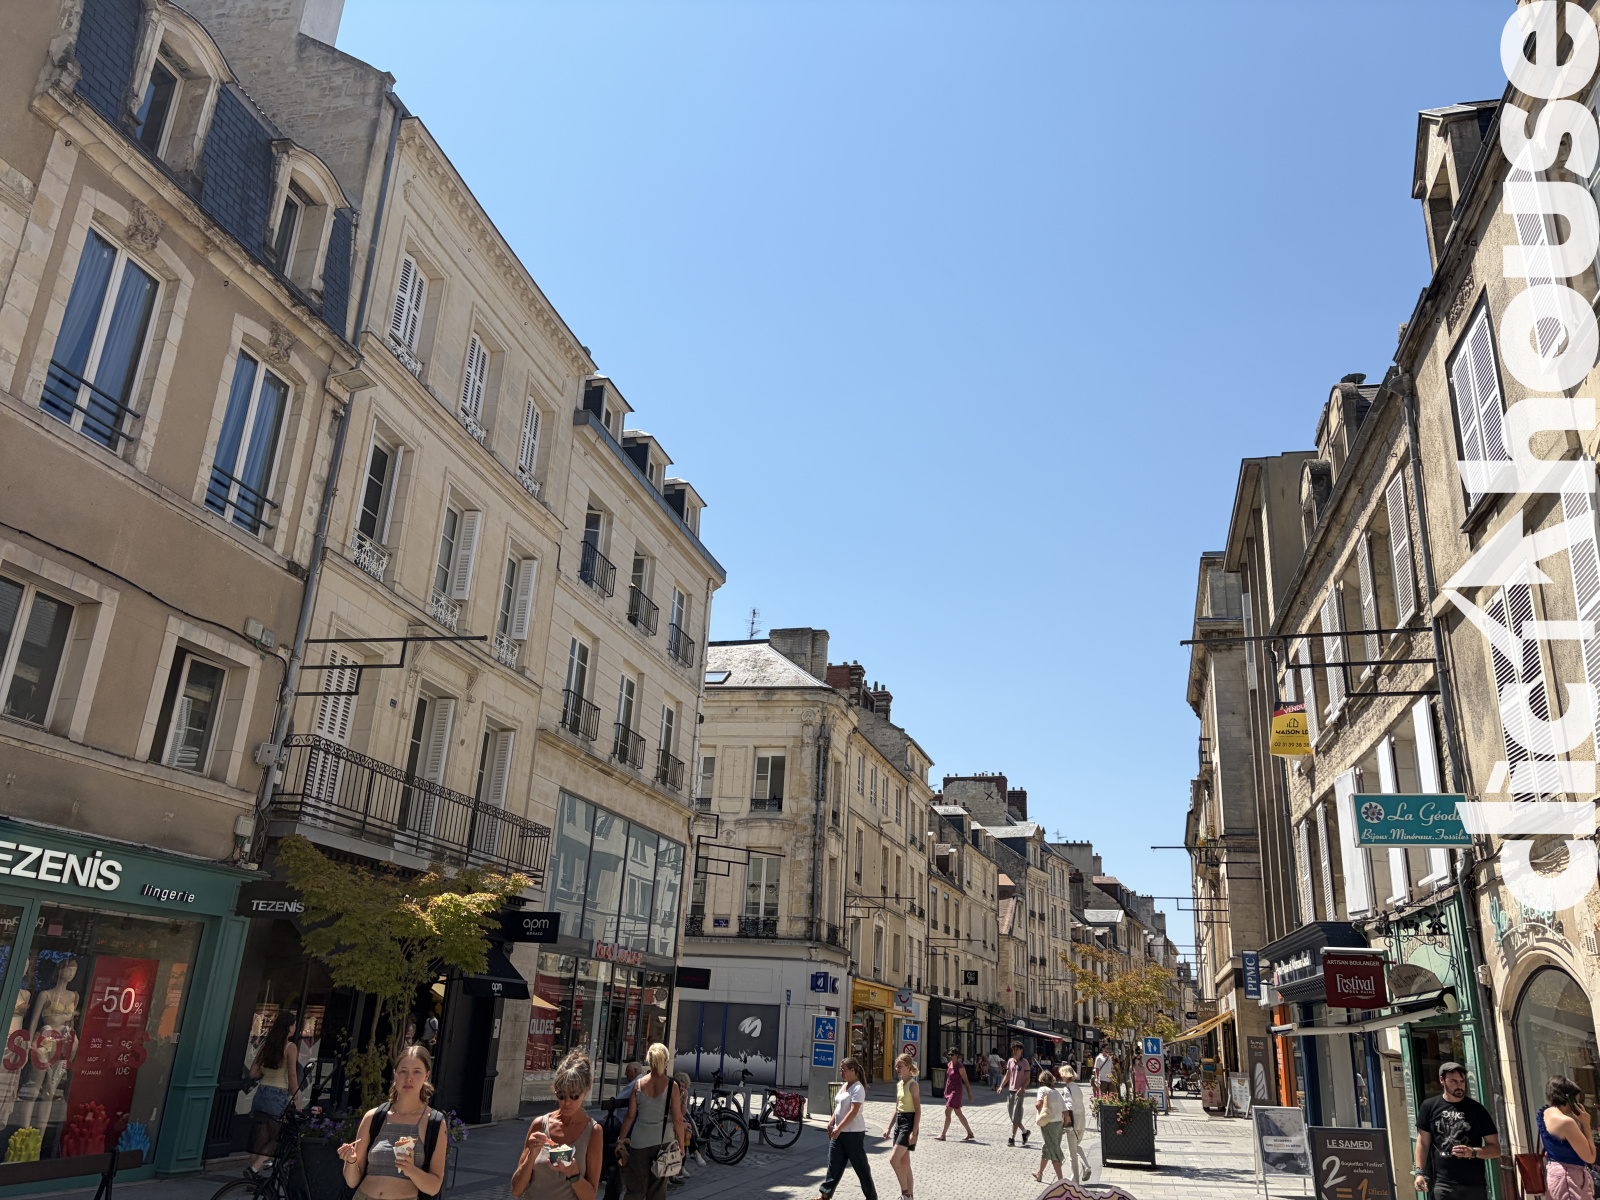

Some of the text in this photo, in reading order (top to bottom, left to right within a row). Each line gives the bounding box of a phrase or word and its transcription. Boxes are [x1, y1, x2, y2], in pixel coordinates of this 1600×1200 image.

[1284, 703, 1305, 713] VENDU
[1387, 802, 1414, 821] La
[143, 884, 196, 903] lingerie
[522, 918, 550, 931] apm
[1245, 957, 1257, 991] PPMC
[1336, 973, 1375, 993] Festival
[491, 982, 503, 992] apm
[1326, 1139, 1373, 1149] LE SAMEDI
[1322, 1155, 1347, 1189] 2
